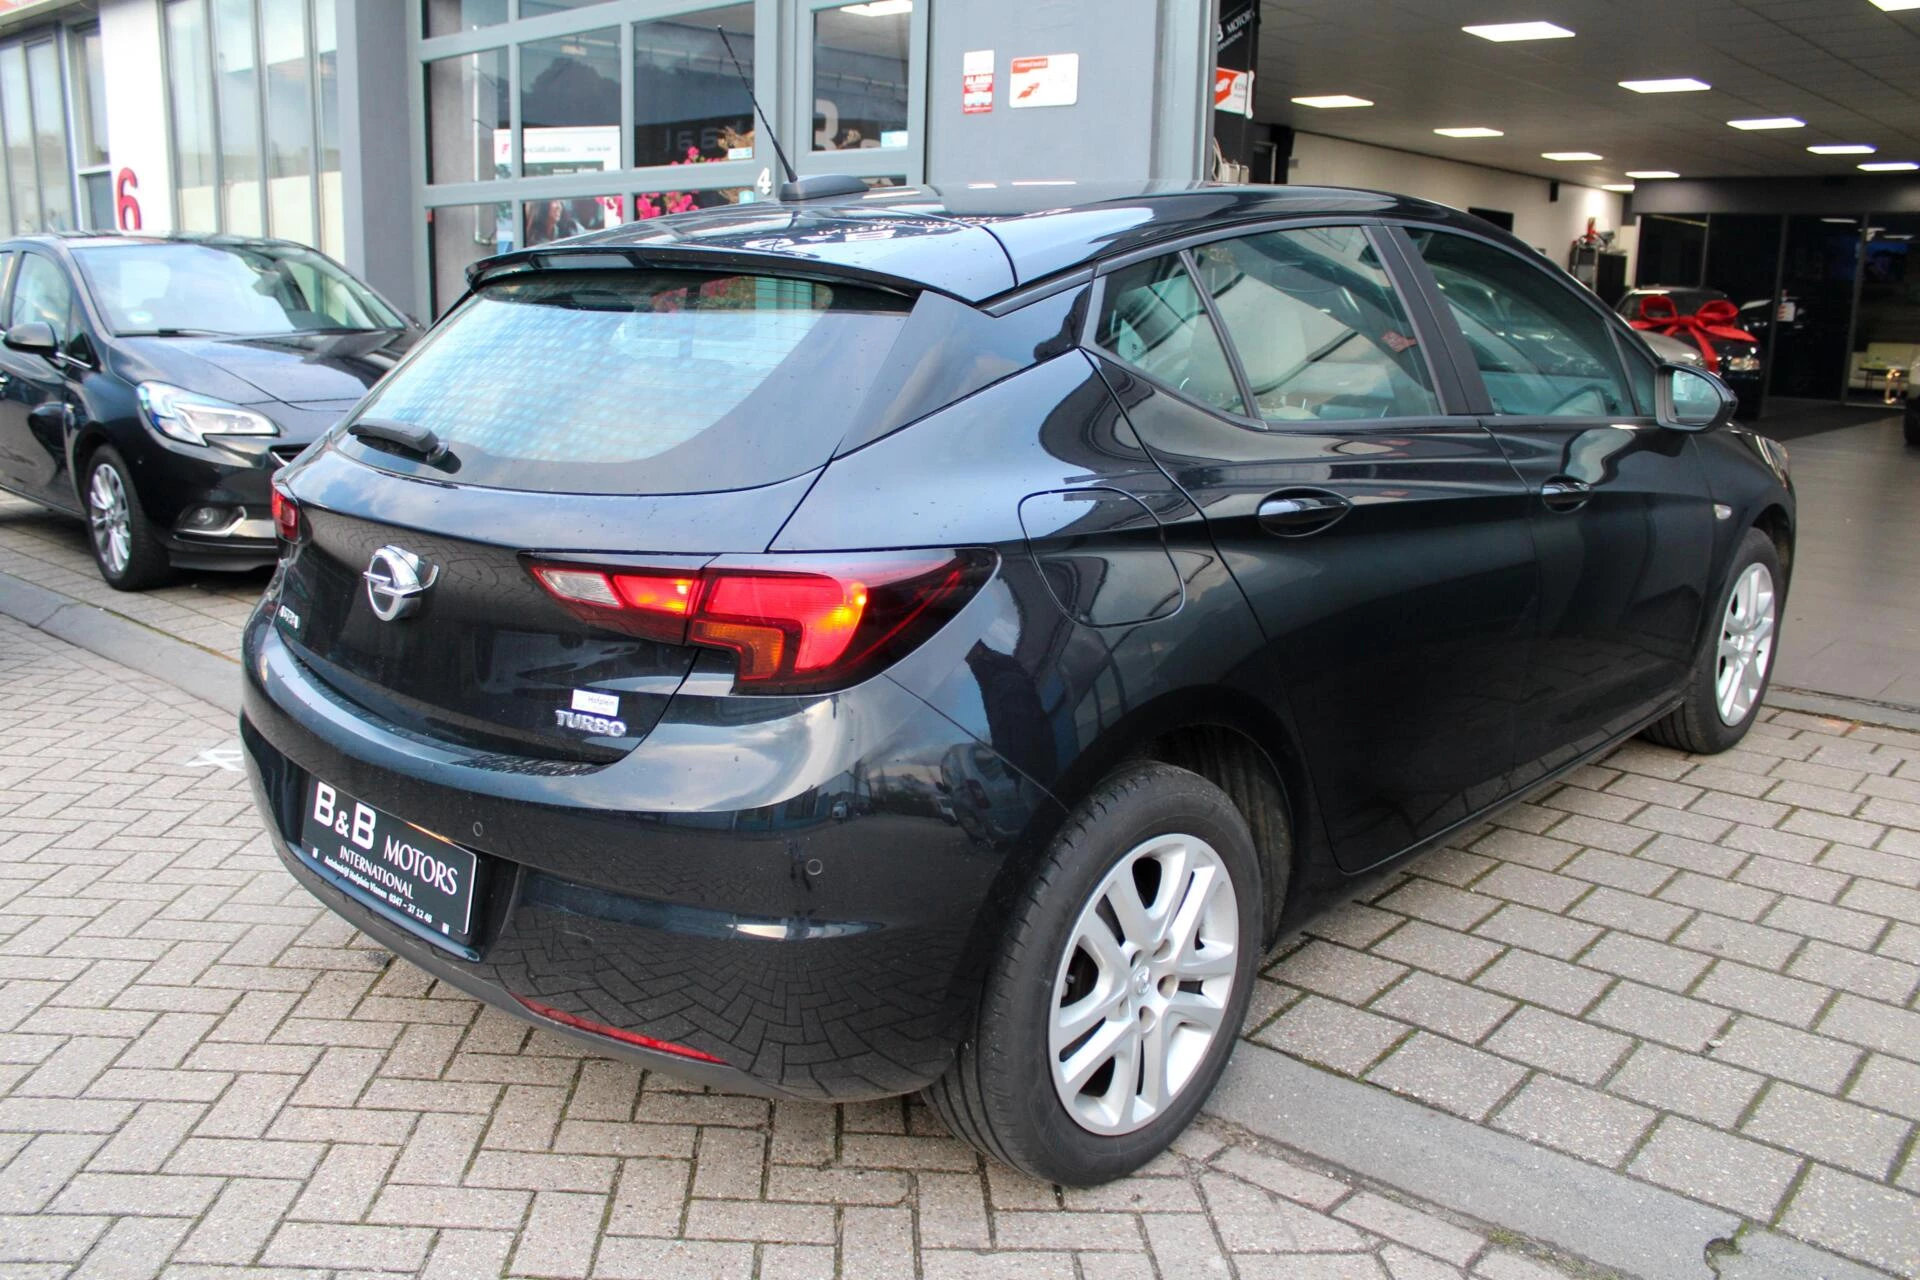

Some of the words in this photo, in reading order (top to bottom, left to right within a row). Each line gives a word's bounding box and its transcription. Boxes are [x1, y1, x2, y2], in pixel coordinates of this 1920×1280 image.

[116, 166, 142, 232] 6
[756, 167, 773, 196] 4
[555, 709, 627, 737] TURBO
[313, 781, 377, 850] B&B
[384, 834, 458, 896] MOTORS
[339, 845, 414, 899] INTERNATIONAL
